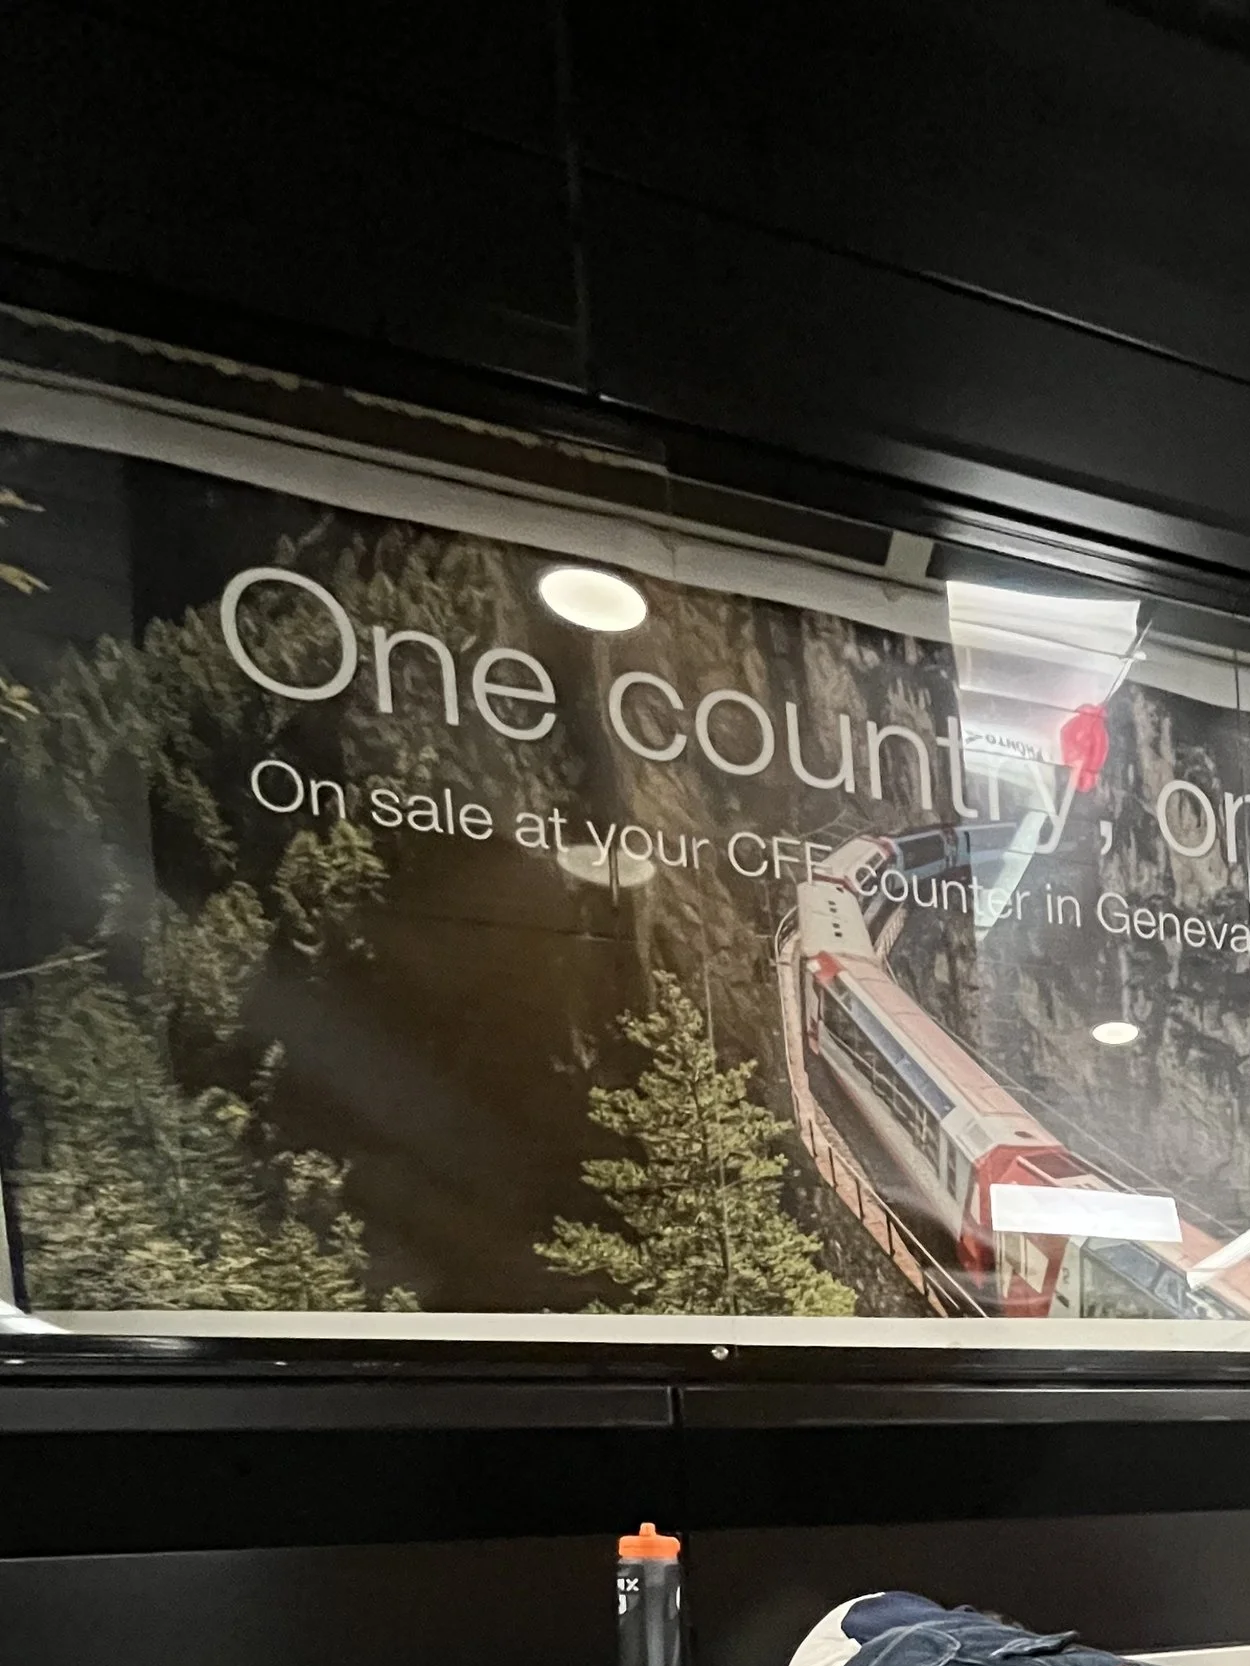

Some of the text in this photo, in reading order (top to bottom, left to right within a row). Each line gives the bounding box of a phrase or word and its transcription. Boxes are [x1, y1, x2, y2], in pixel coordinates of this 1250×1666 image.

[220, 566, 556, 741] One
[607, 671, 1113, 856] country,
[250, 759, 346, 820] On
[371, 788, 494, 840] sale
[515, 806, 570, 853] at
[588, 818, 713, 871] your
[729, 831, 833, 885] CFF
[856, 863, 1031, 920] counter
[1046, 882, 1082, 928] in
